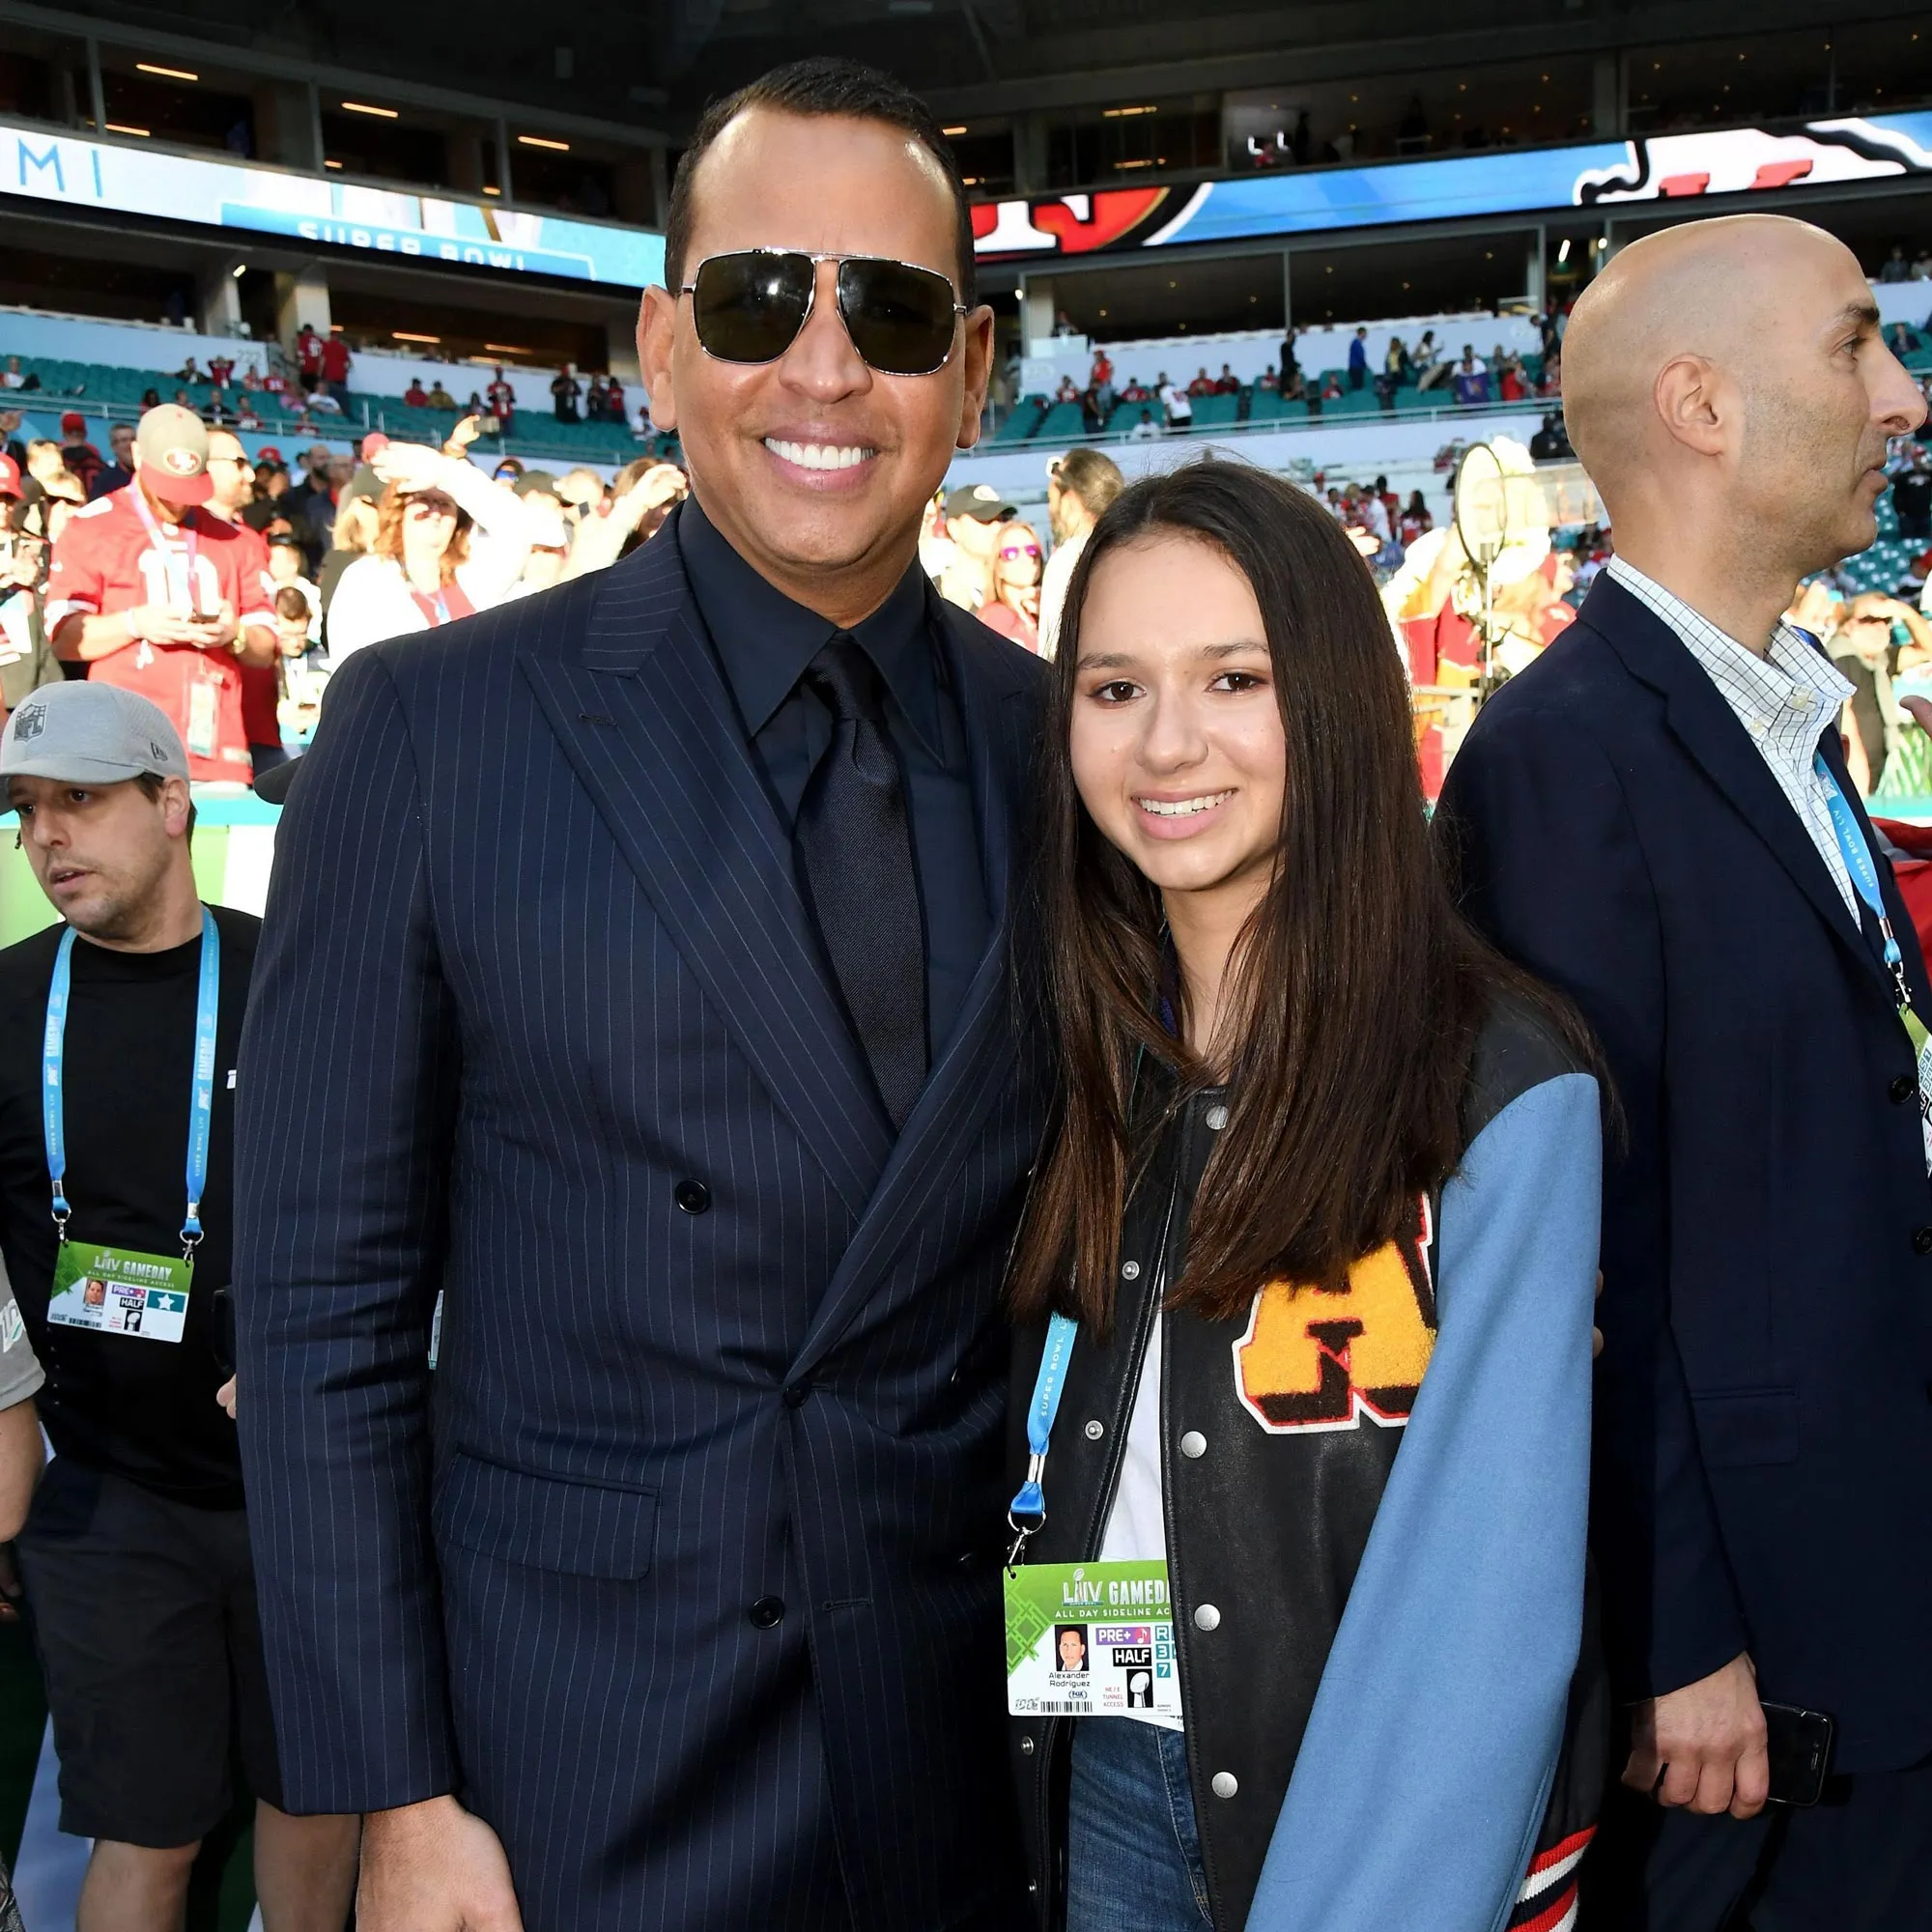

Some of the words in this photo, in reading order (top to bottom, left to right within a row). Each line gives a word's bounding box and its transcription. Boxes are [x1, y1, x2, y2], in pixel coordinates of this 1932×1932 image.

[1843, 827, 1859, 854] BOWL
[123, 1260, 173, 1282] GAMEDAY
[120, 1297, 144, 1309] HALF
[1041, 1377, 1054, 1416] SUPER
[1050, 1337, 1064, 1371] BOWL
[1108, 1579, 1170, 1605] GAMED
[1055, 1609, 1074, 1618] ALL
[1079, 1608, 1098, 1617] DAY
[1103, 1607, 1151, 1617] SIDELINE
[1156, 1627, 1168, 1640] R
[1115, 1648, 1151, 1663] HALF
[1157, 1644, 1168, 1658] 3
[1158, 1663, 1168, 1677] 7
